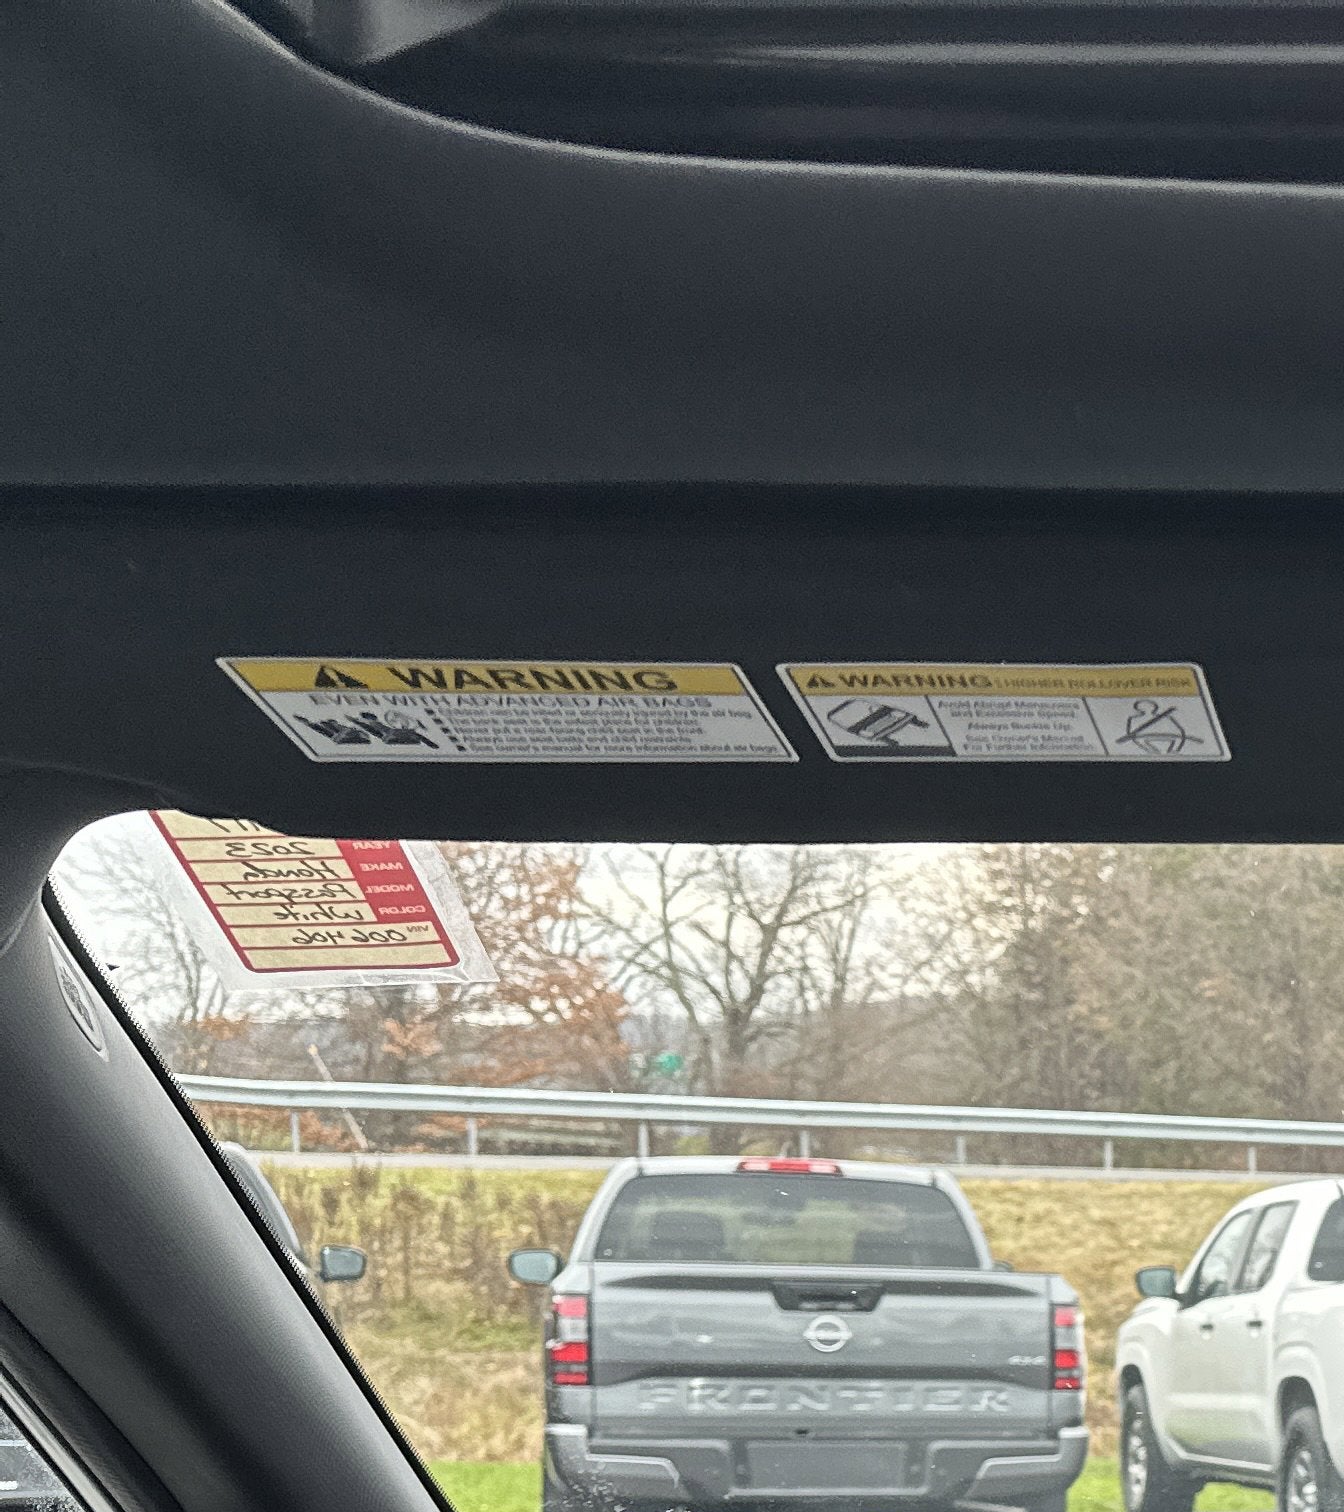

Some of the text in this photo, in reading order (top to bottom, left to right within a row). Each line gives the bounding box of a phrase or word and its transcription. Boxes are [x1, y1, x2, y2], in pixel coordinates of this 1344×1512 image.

[386, 667, 679, 691] WARNING
[838, 674, 994, 690] WARNING
[307, 693, 379, 707] EVEN
[638, 1380, 1009, 1412] FRONTIER
